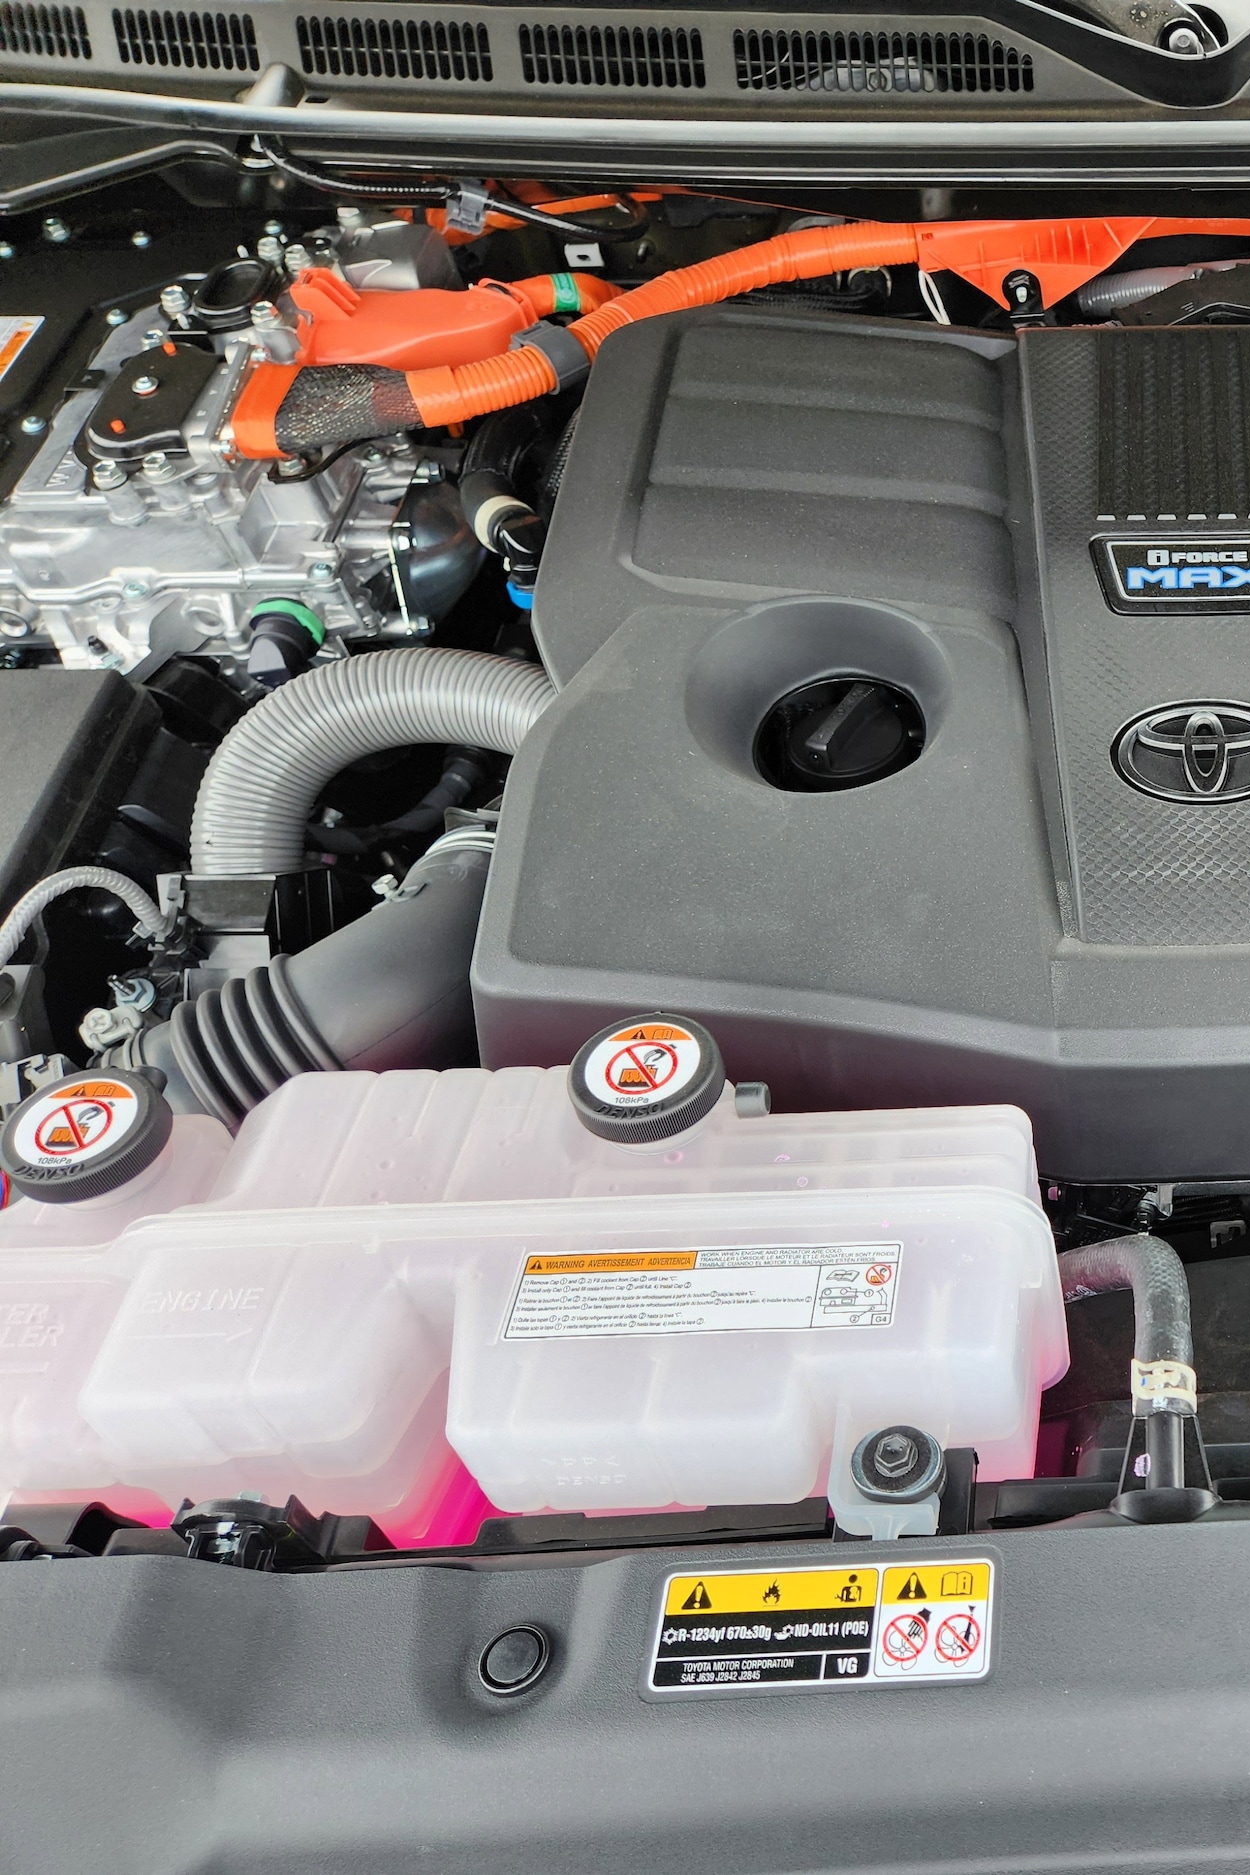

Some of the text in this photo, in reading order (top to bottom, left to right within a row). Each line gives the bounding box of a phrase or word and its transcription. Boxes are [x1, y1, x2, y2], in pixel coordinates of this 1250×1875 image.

[614, 1096, 650, 1104] 108kPa
[594, 1102, 664, 1120] DENSO
[13, 1163, 85, 1181] DENSO
[545, 1256, 691, 1269] WARNING AVERTISSEMENT ADVERTENCIA
[140, 1287, 265, 1314] ENGINE
[875, 1315, 887, 1323] G4
[677, 1621, 869, 1643] R-1234yf 670±30g ND-OIL11 (POE)
[683, 1658, 794, 1673] TOYOTA MOTOR CORPORATION
[837, 1657, 859, 1675] VG
[680, 1670, 761, 1684] SAE J639 J2842 J2845
